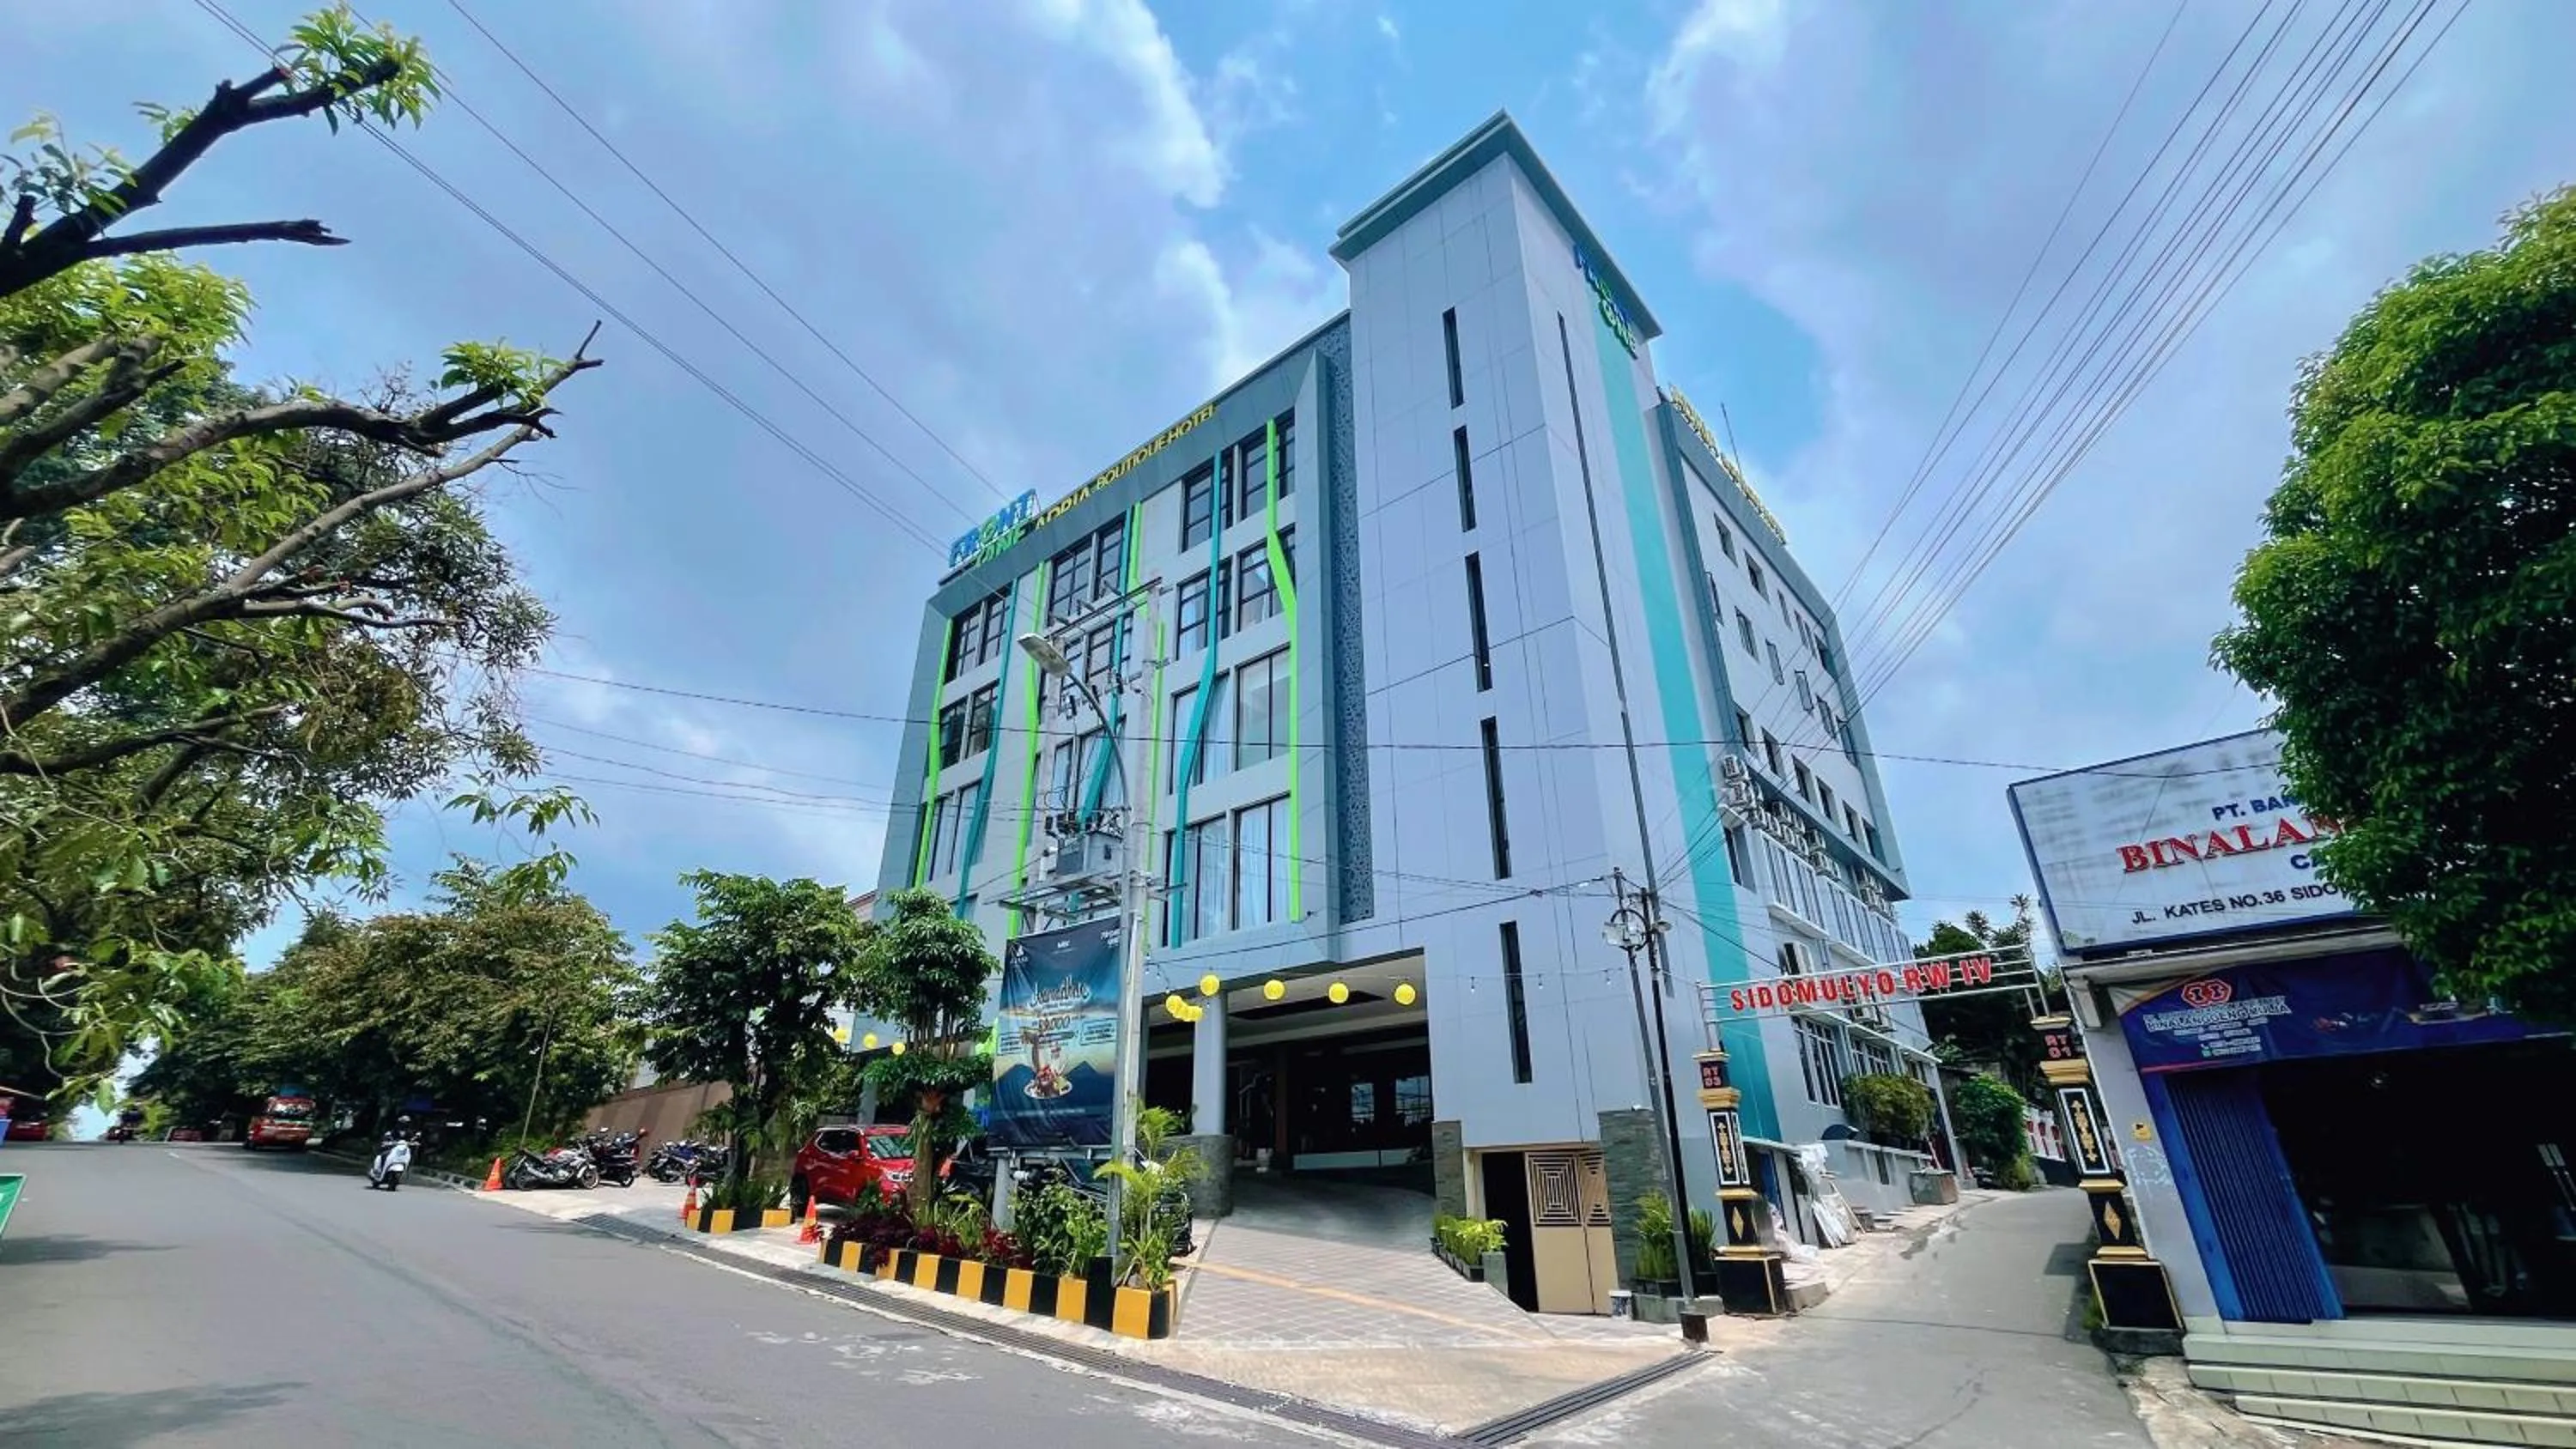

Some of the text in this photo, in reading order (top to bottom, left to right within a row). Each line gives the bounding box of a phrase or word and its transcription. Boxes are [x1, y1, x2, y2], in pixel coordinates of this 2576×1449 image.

[2212, 803, 2246, 822] PT.
[2132, 911, 2156, 925] JL.
[2164, 898, 2226, 919] KATES
[2229, 889, 2286, 911] NO.36
[1730, 955, 1991, 1011] SIDOMULYO RW IV
[2044, 1034, 2068, 1046] RT
[1703, 1066, 1718, 1077] RT
